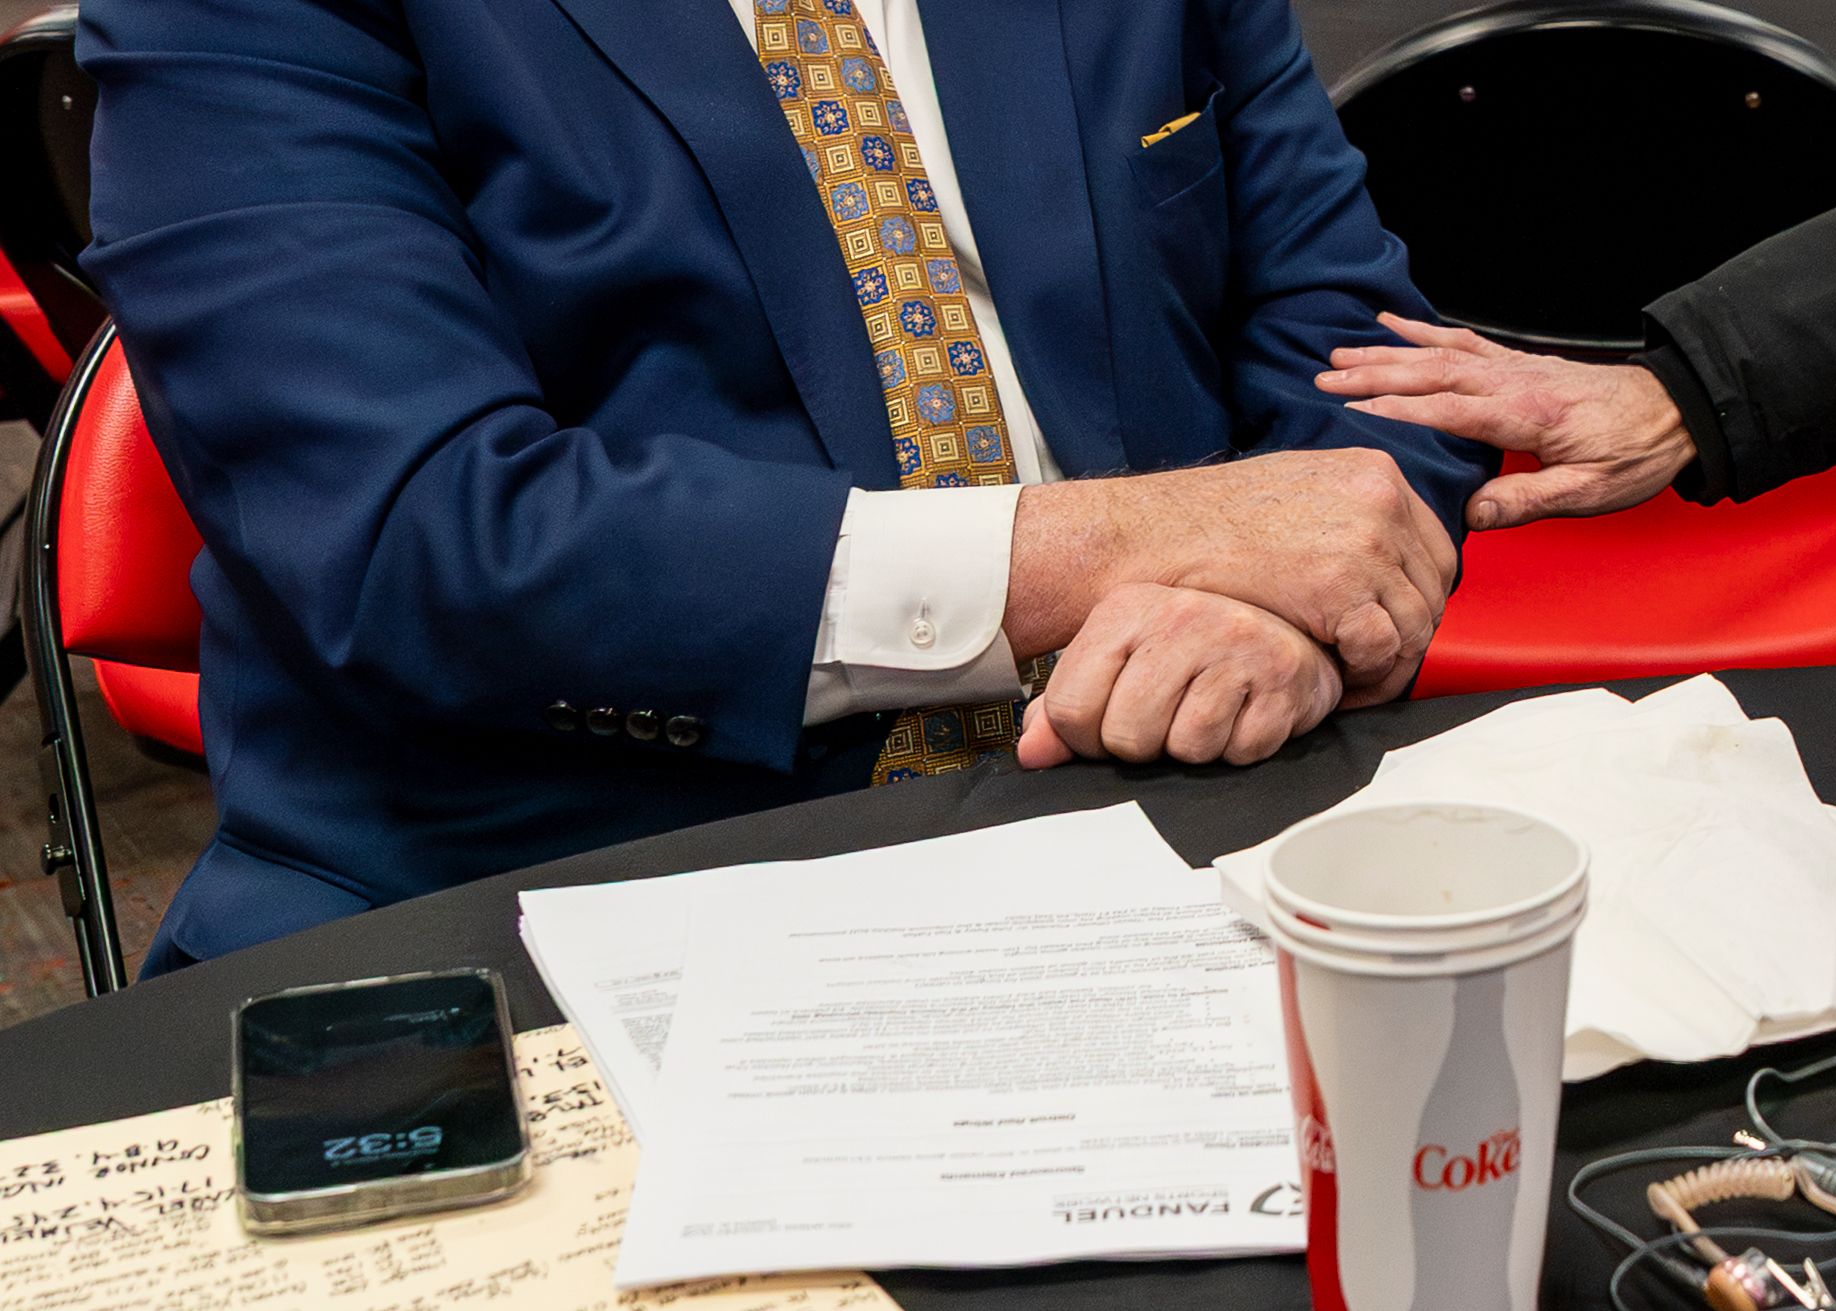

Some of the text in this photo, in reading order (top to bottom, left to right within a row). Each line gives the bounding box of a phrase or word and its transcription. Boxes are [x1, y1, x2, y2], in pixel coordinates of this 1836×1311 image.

[322, 1125, 443, 1161] 5:32
[1411, 1137, 1521, 1193] Coke
[1052, 1201, 1230, 1224] FANDUEL
